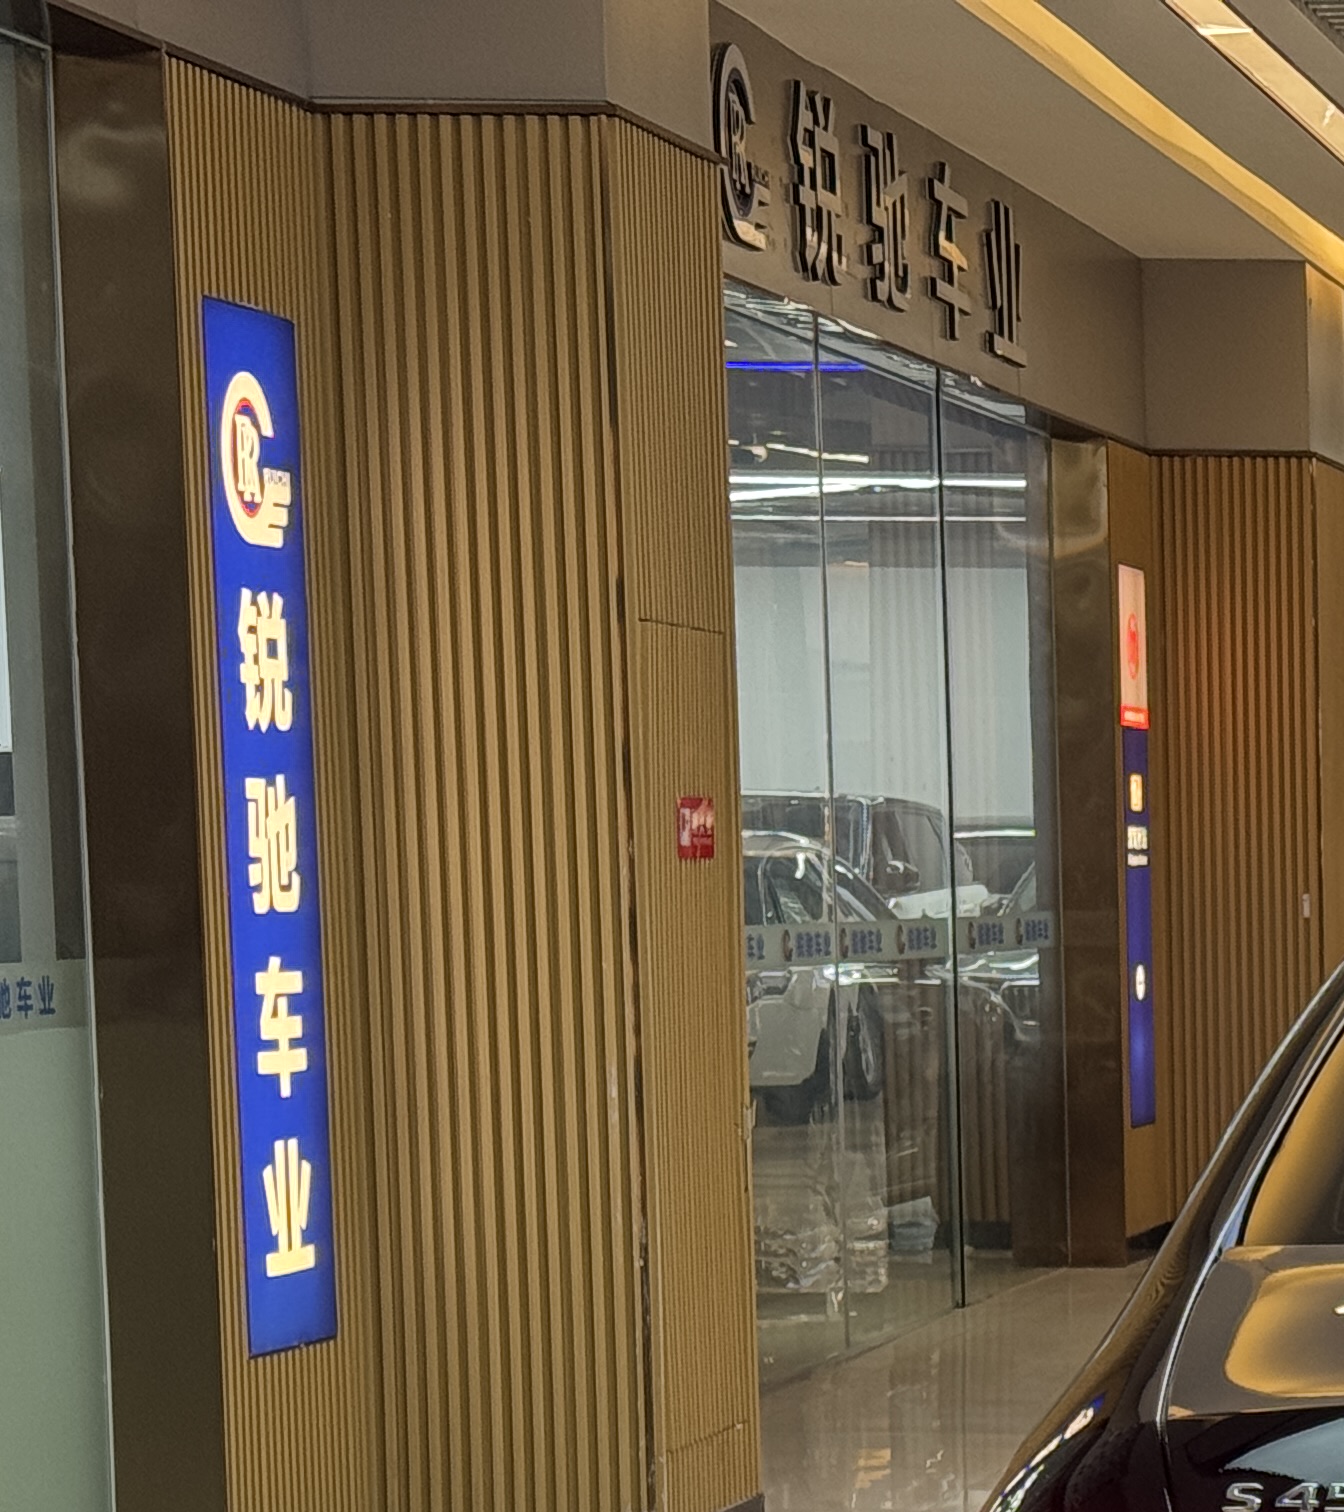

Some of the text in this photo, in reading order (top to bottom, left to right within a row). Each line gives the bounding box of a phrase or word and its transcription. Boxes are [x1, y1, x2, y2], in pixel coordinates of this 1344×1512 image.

[787, 78, 1027, 368] 锐驰车业
[238, 586, 316, 1278] 锐驰车业
